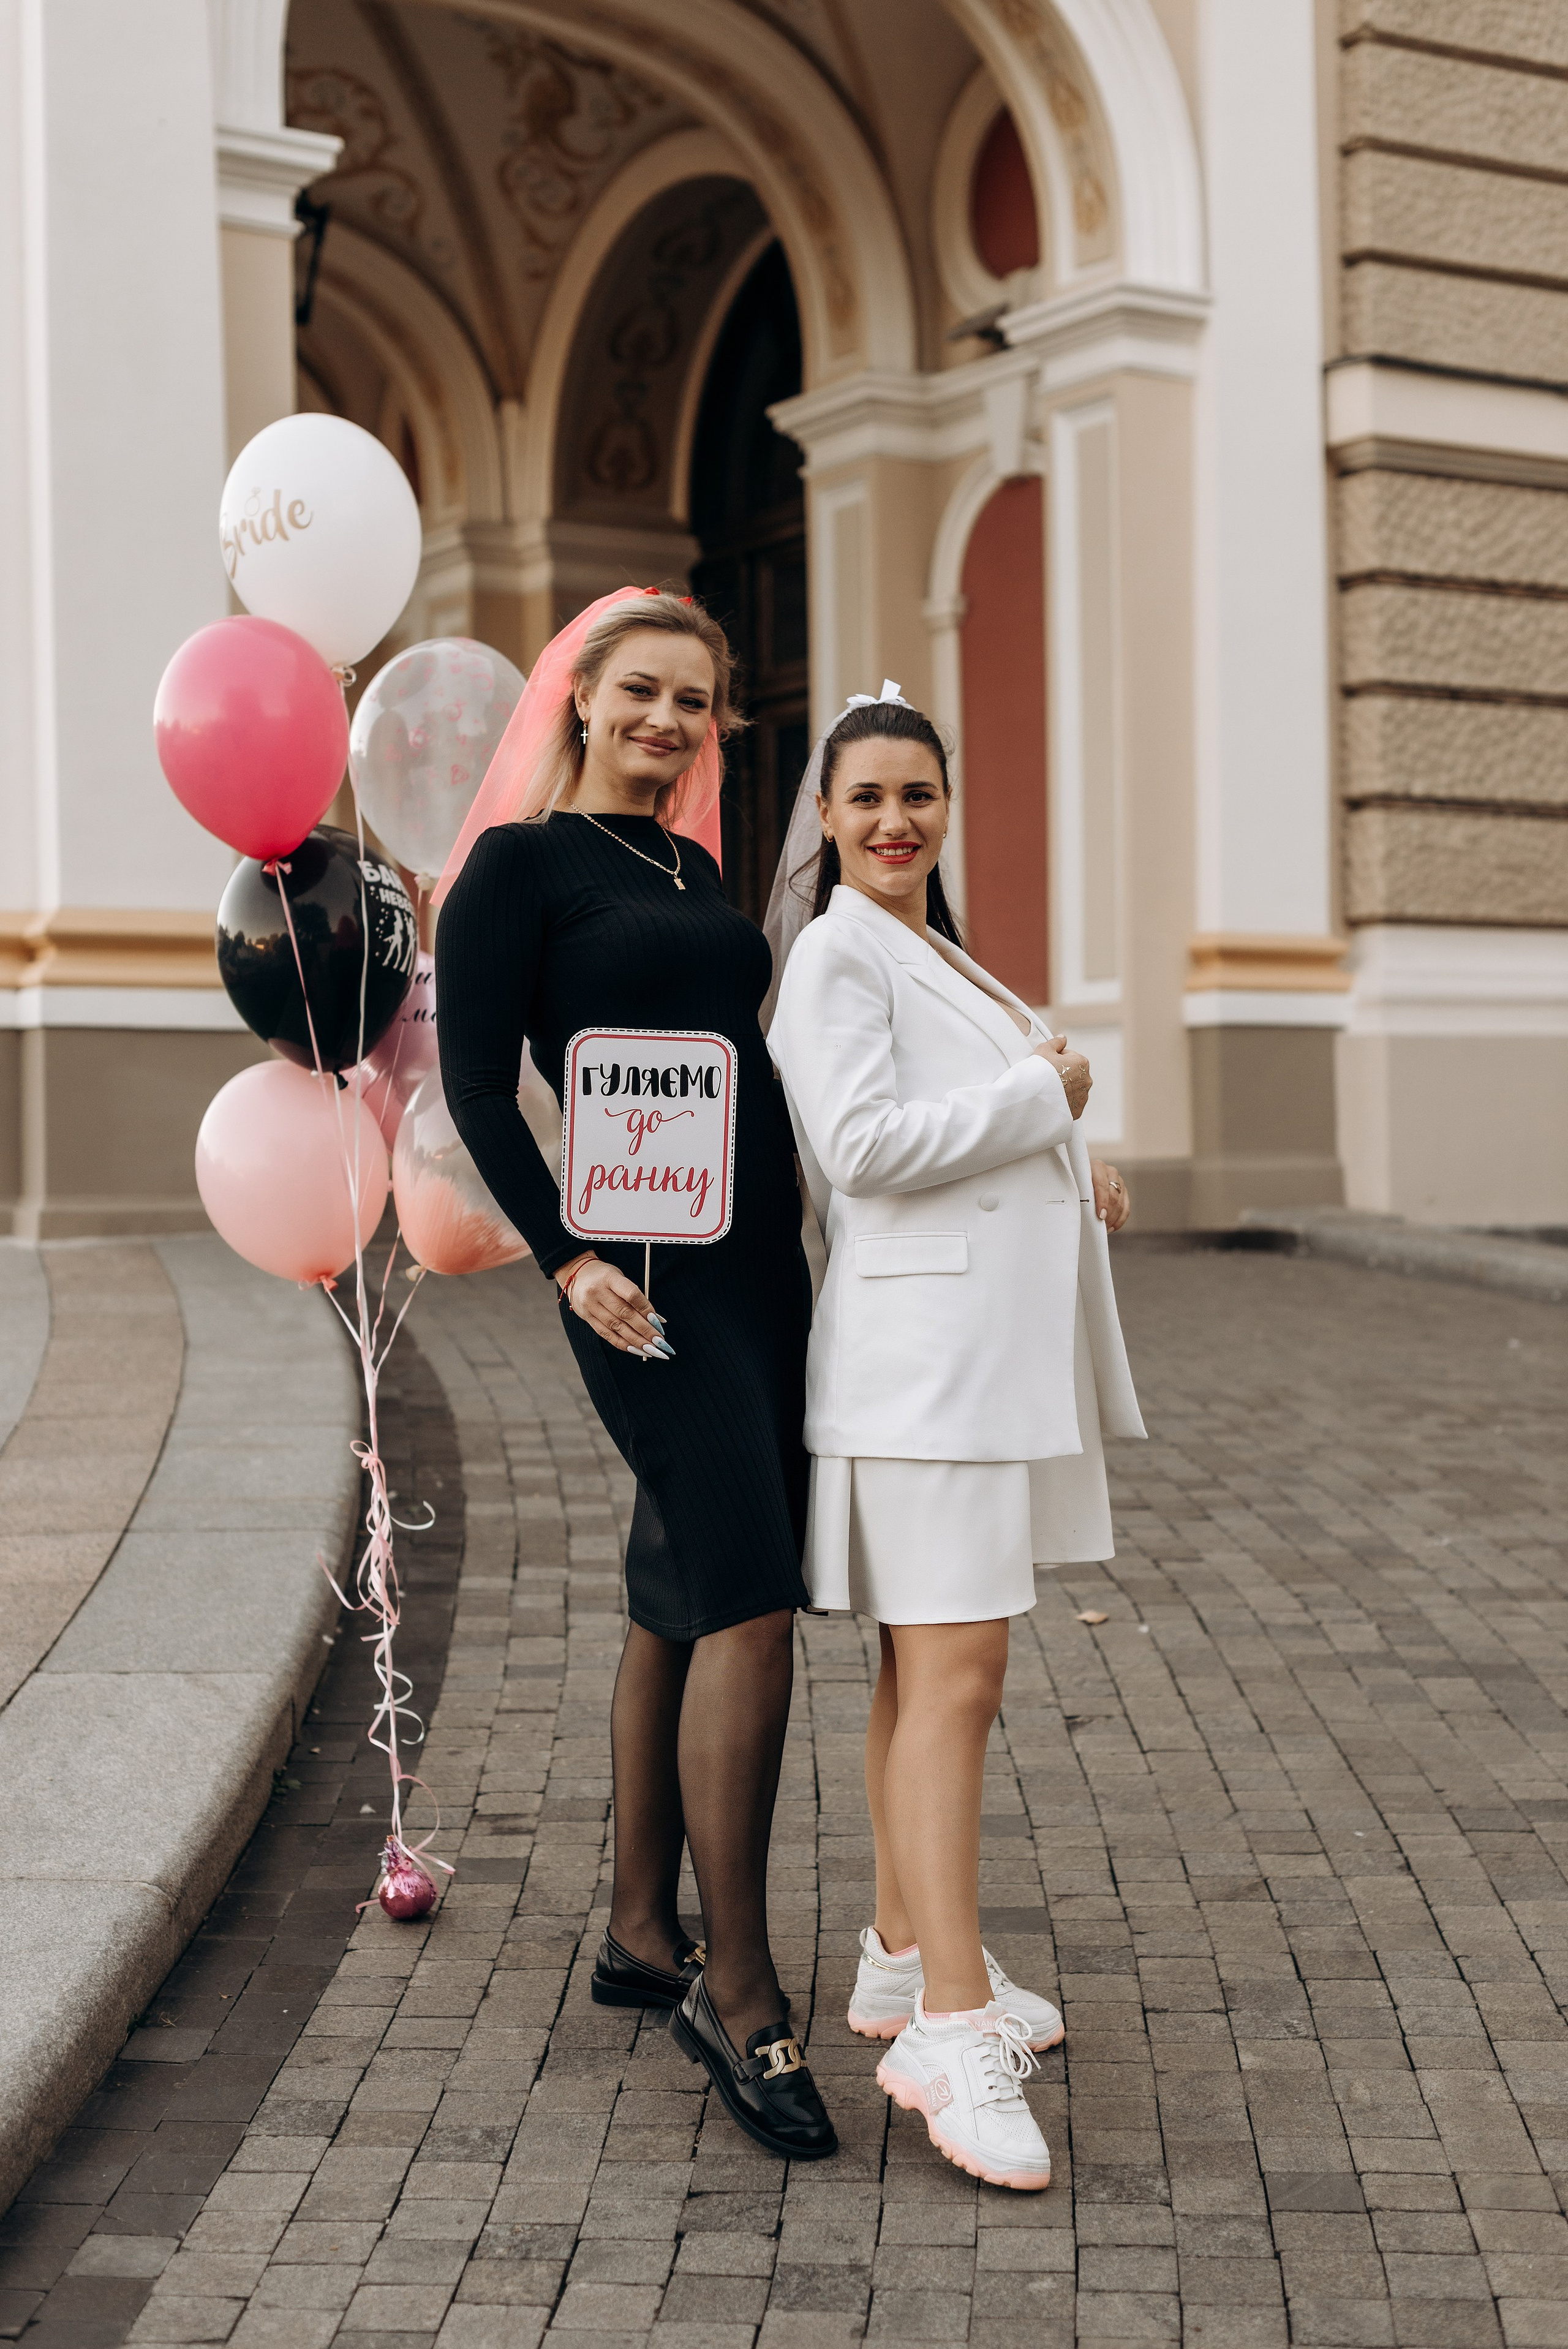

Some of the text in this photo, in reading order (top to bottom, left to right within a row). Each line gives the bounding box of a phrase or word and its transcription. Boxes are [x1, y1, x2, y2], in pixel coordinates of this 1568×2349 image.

[582, 1063, 722, 1098] ГУЛЯЄМО
[605, 1108, 695, 1155] до
[579, 1164, 715, 1218] ранку
